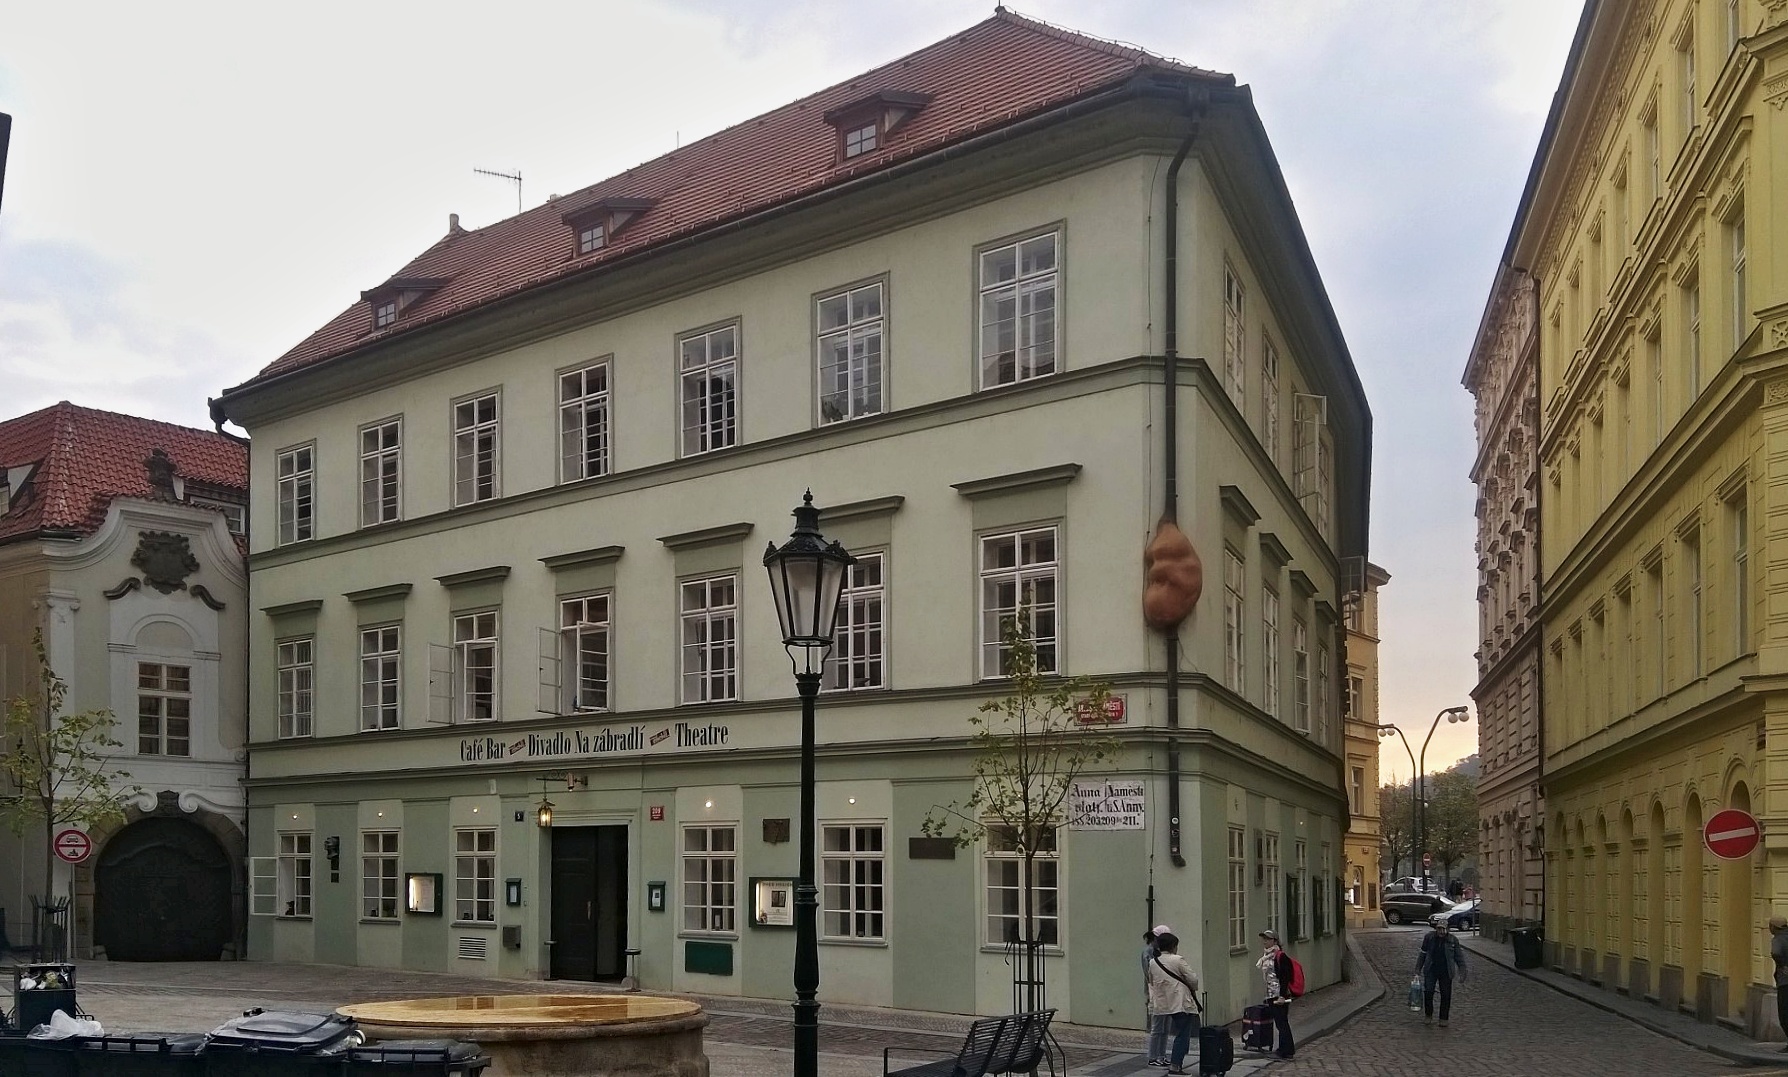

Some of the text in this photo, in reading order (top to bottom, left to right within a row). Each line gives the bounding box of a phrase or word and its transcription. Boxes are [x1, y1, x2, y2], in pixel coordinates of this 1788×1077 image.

[461, 738, 483, 761] Café
[487, 737, 506, 760] Bar
[528, 731, 571, 756] Divadlo
[575, 730, 589, 753] Na
[593, 725, 646, 752] zábradlí
[675, 722, 729, 747] Theatre
